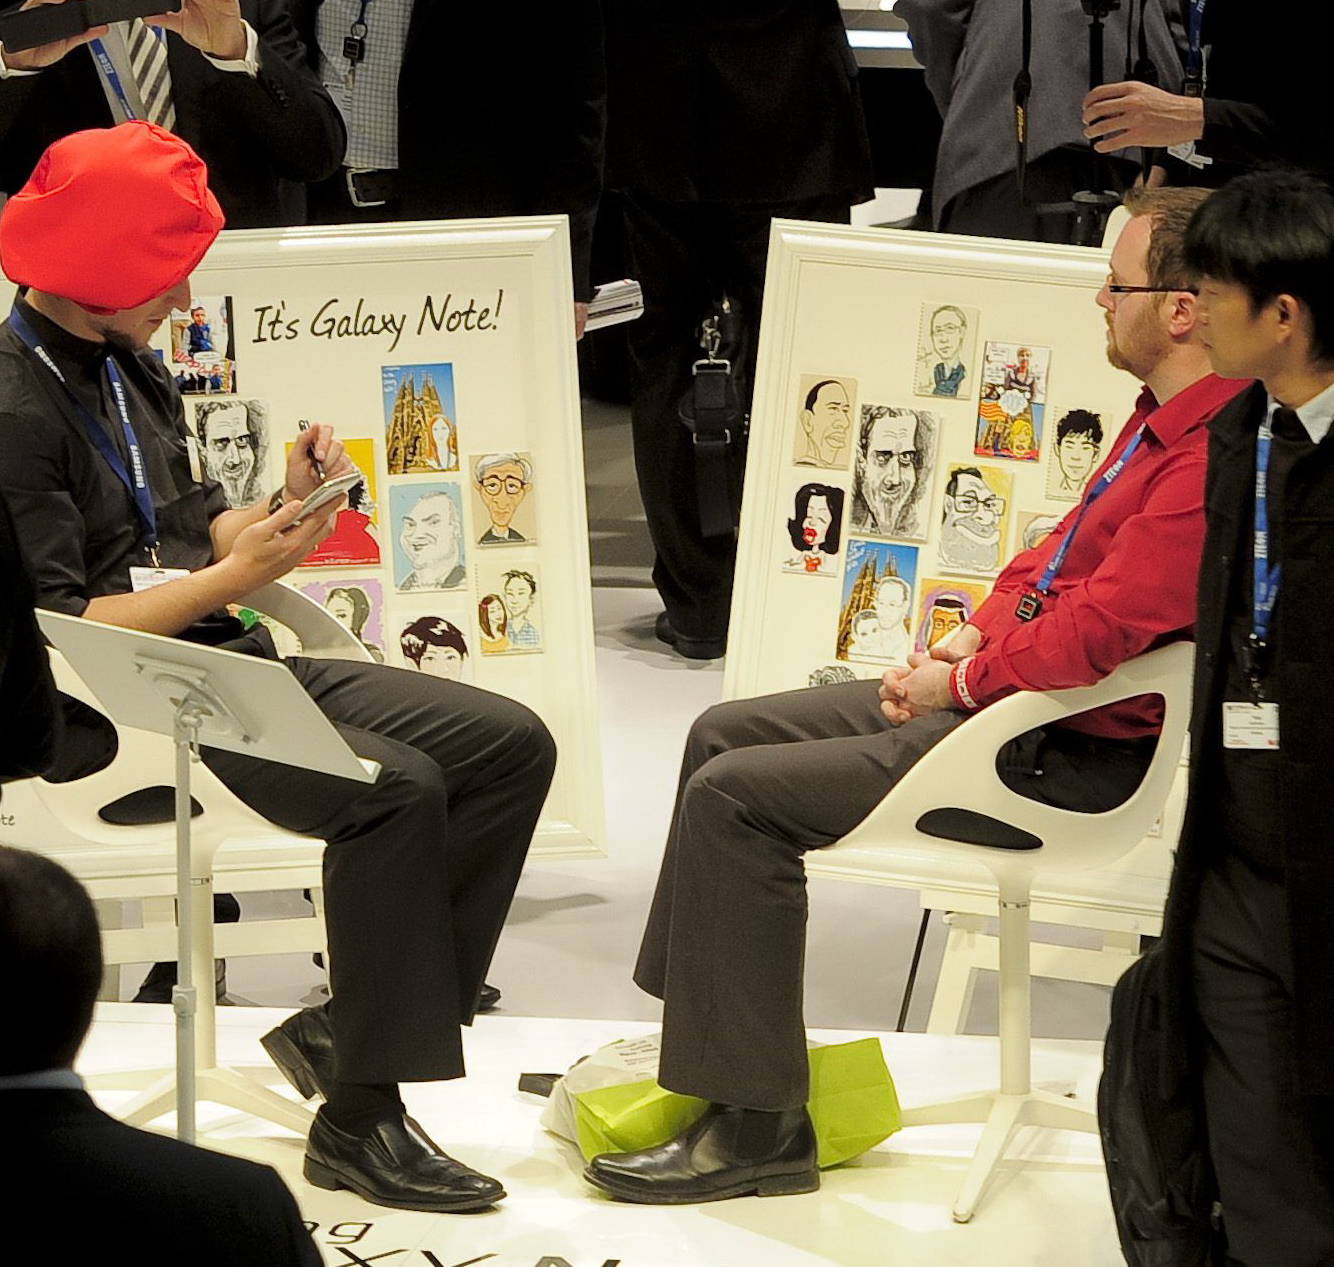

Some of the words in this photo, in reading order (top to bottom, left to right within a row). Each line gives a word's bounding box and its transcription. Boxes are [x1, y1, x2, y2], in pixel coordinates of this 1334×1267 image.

[251, 299, 300, 344] It's
[309, 297, 407, 353] Galaxy
[416, 288, 504, 337] Note!
[112, 381, 130, 424] SAMSUNG
[129, 444, 146, 489] SAMSUNG
